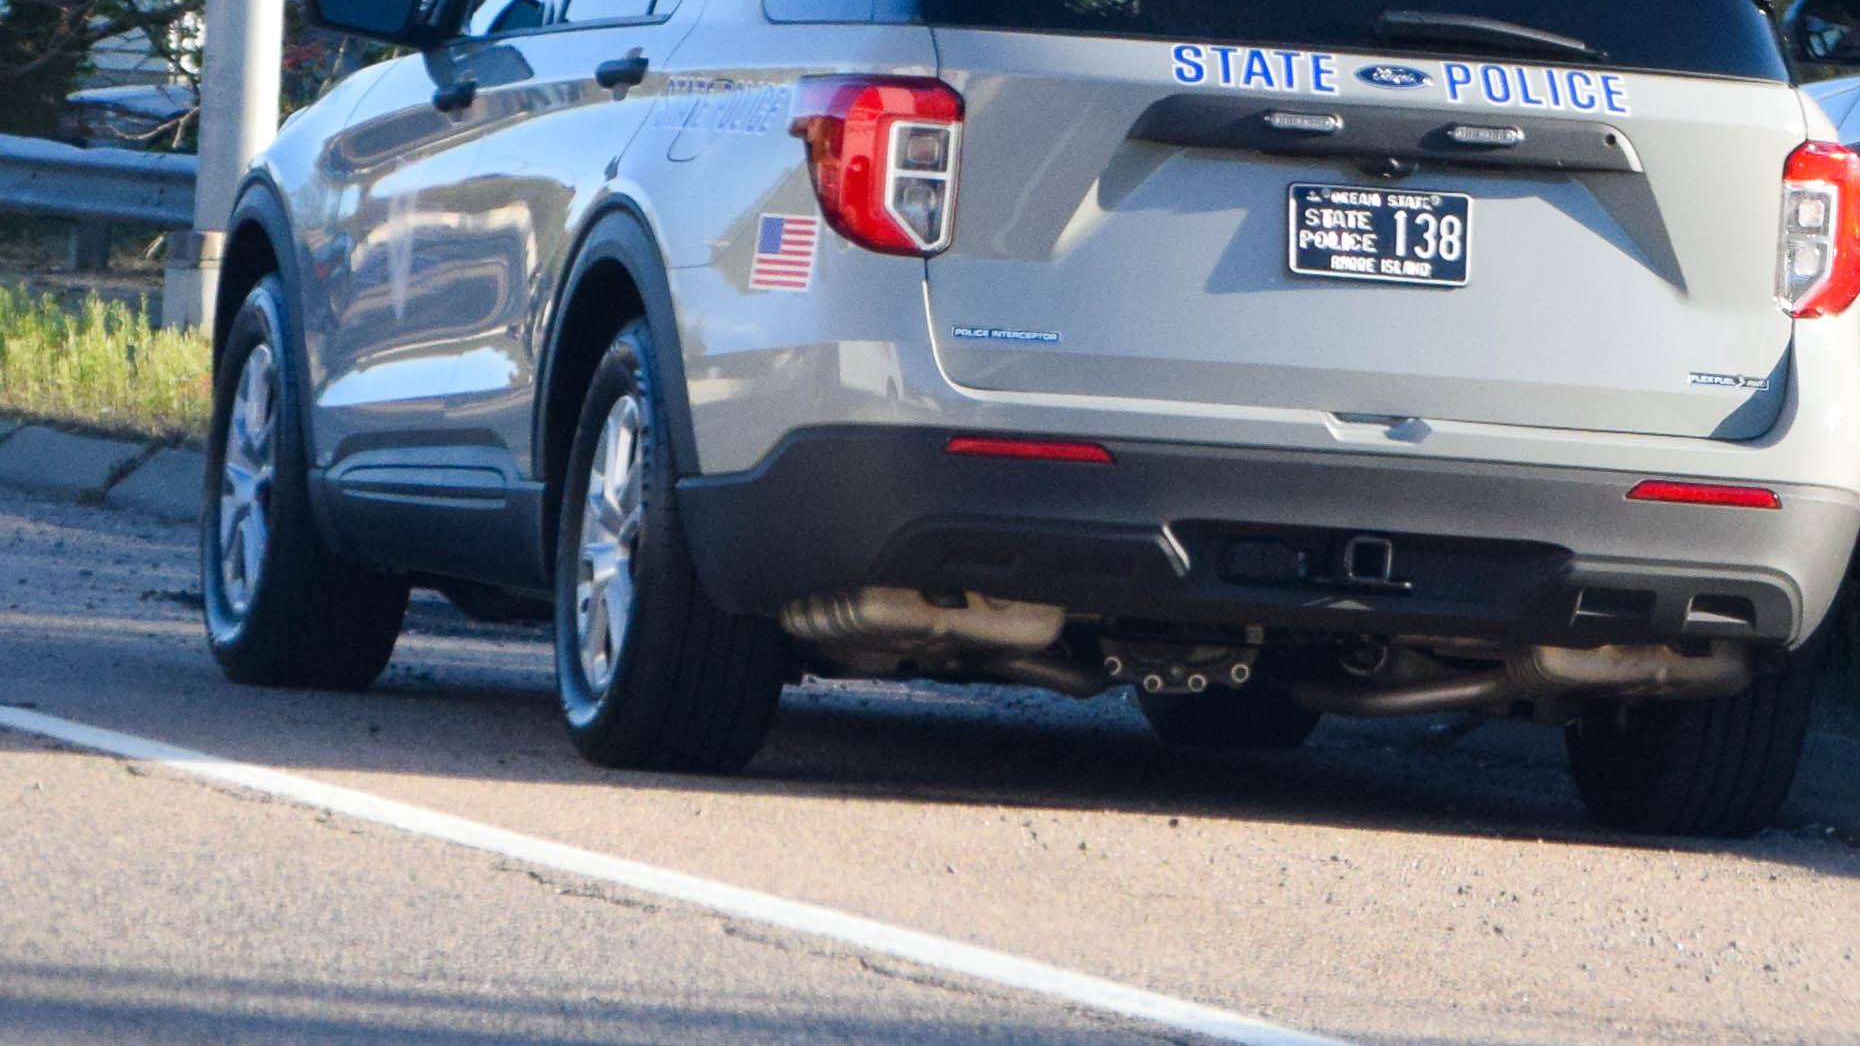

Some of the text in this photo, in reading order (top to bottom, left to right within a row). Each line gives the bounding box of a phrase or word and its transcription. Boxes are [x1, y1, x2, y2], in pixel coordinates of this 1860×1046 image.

[1172, 44, 1337, 93] STATE
[1443, 61, 1628, 114] POLICE
[1387, 194, 1433, 210] STATE
[1299, 229, 1378, 253] POLICE
[1305, 208, 1462, 261] STATE 138
[1381, 258, 1432, 278] ISLAND
[955, 328, 989, 337] POLICE
